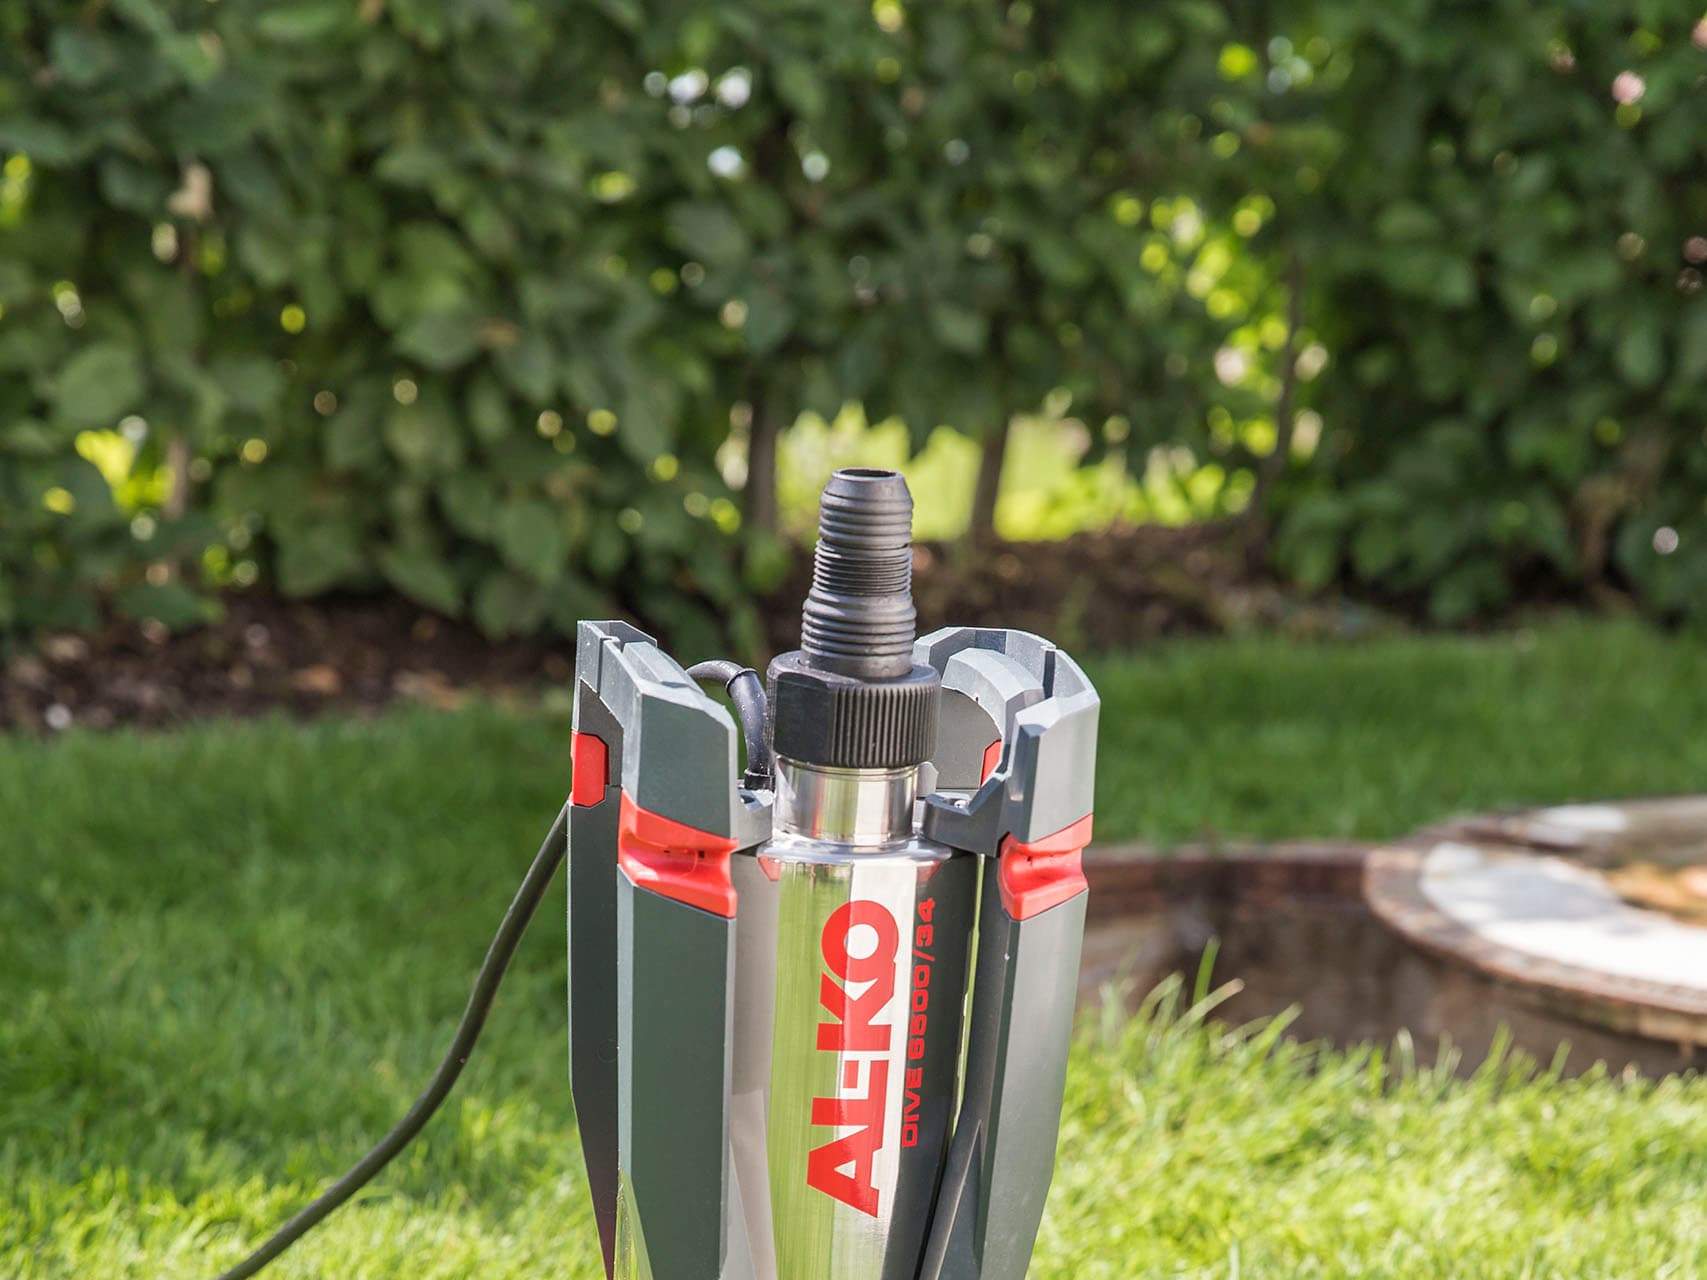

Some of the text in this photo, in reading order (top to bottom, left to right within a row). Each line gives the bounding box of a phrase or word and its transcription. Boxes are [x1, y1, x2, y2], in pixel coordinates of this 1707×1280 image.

[807, 900, 899, 1218] AL-KO
[902, 898, 936, 1147] DIVE 6500/34
